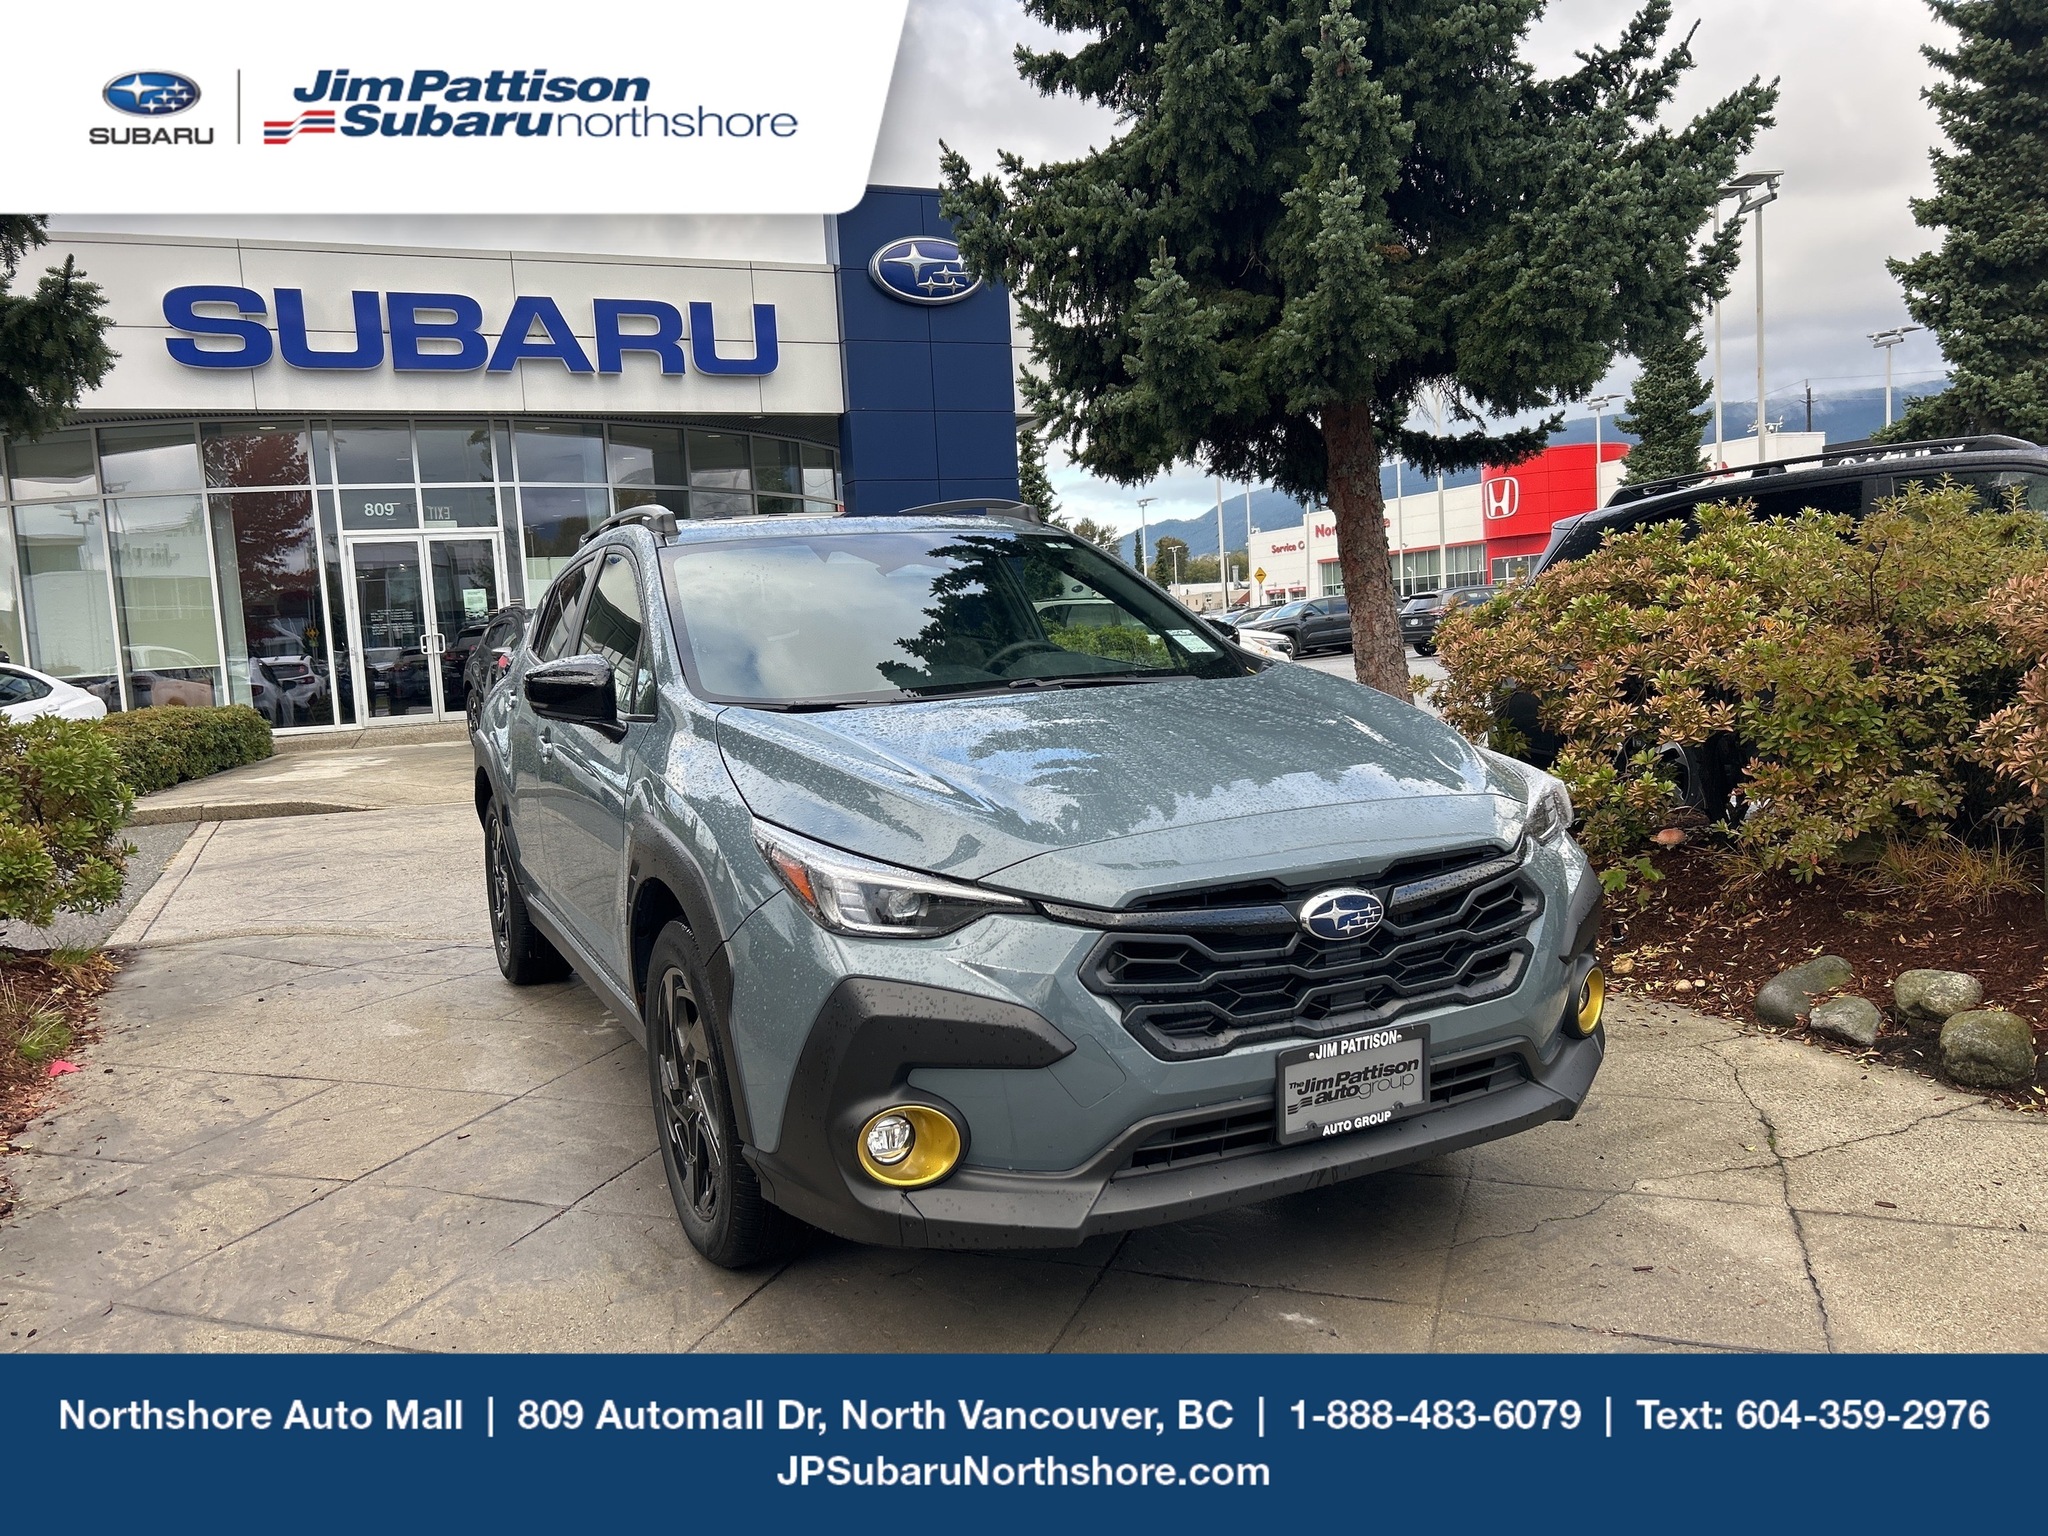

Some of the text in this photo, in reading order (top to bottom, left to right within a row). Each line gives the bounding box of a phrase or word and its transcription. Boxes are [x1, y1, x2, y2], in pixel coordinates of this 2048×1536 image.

[163, 285, 779, 376] SUBARU
[364, 502, 394, 516] 809
[1270, 543, 1297, 554] Service
[1315, 1030, 1398, 1060] JIM PATTISON
[1322, 1110, 1392, 1137] AUTO GROUP
